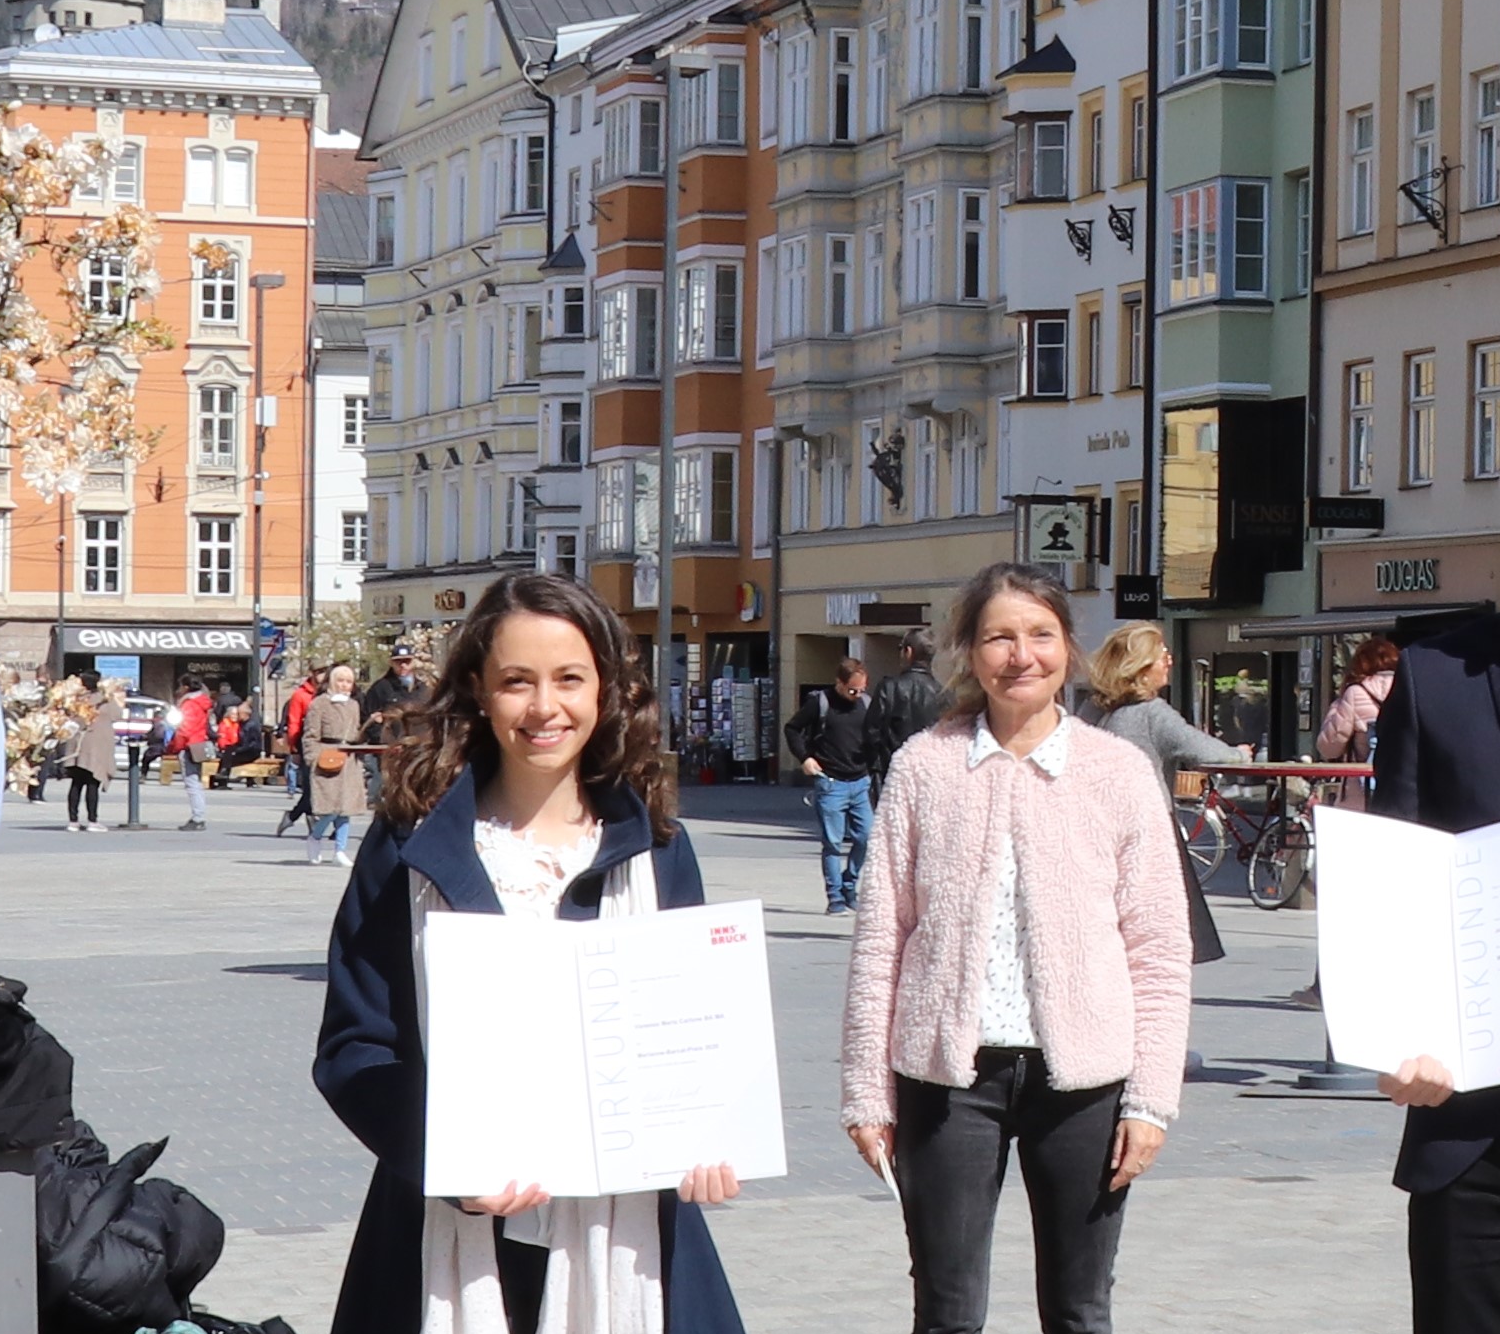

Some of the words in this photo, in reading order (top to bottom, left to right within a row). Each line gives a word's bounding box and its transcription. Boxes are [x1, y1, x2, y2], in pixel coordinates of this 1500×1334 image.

[1375, 558, 1437, 593] DOUGLAS
[710, 932, 748, 945] BRUCK
[1455, 847, 1495, 1052] URKUNDE
[583, 937, 635, 1152] URKUNDE
